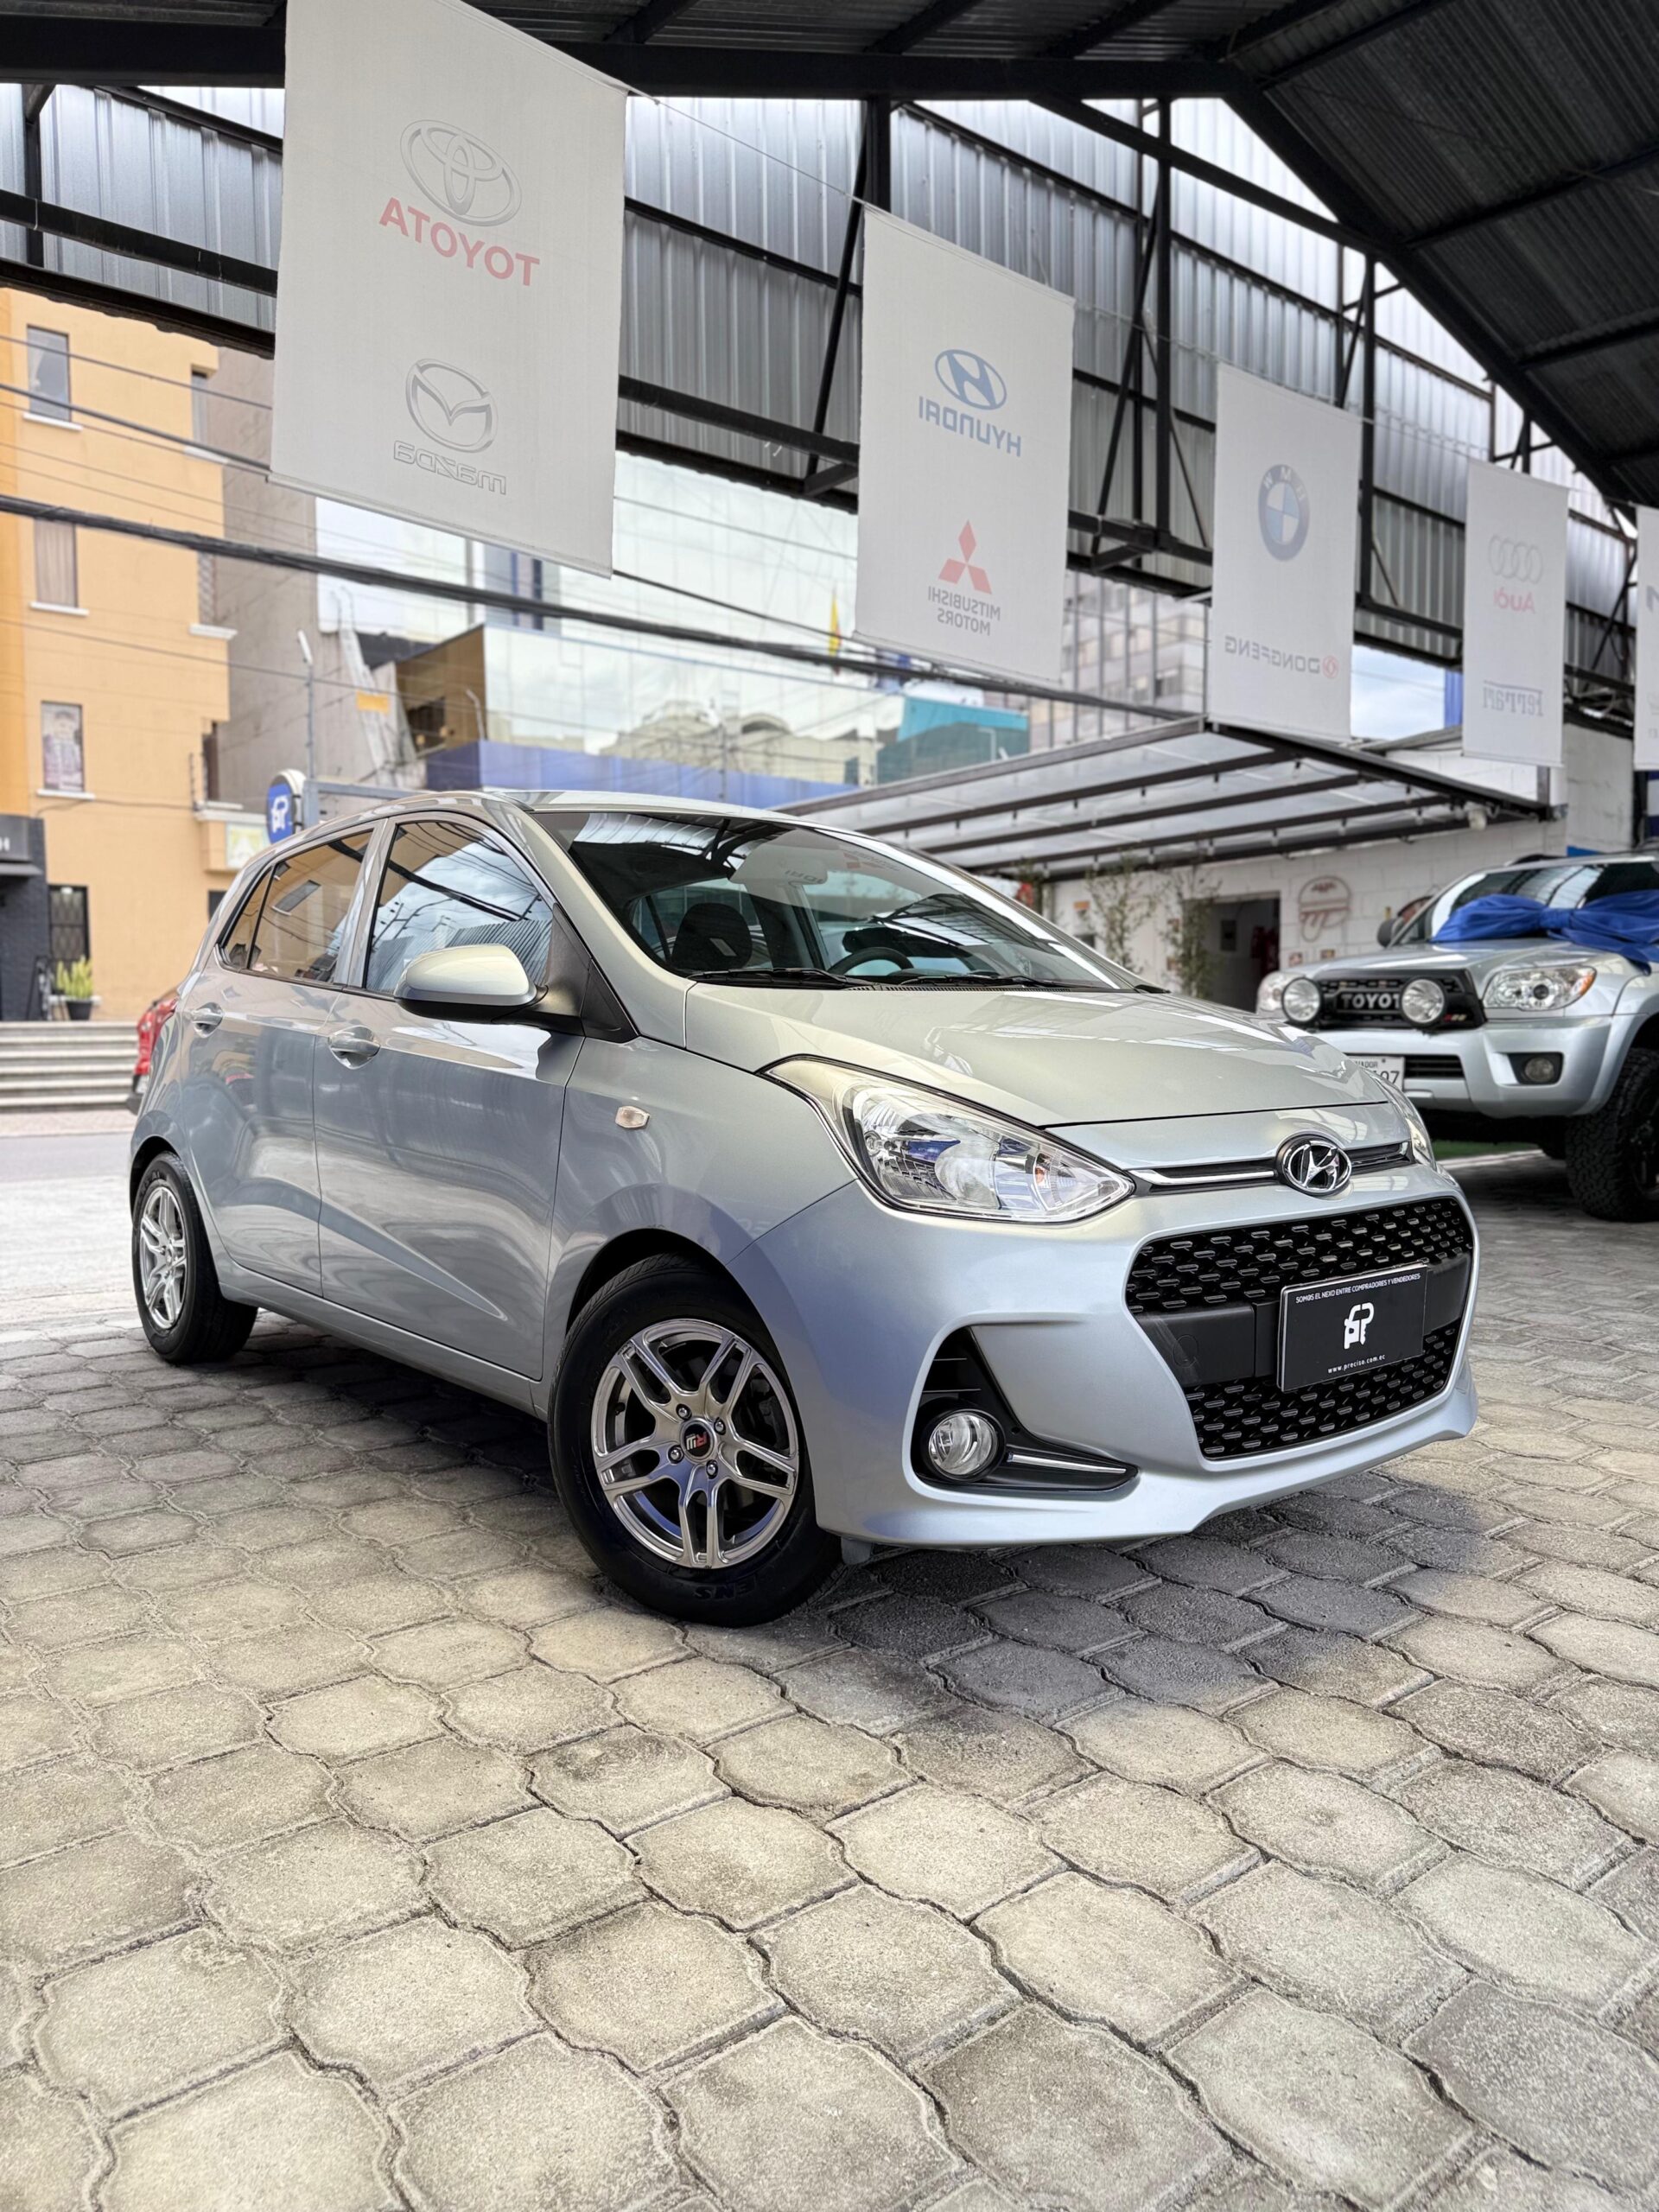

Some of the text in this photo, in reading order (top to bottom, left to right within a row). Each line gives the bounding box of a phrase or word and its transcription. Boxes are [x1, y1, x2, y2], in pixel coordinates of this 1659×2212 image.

[1340, 993, 1400, 1009] TOYOT
[1295, 1294, 1314, 1303] SOMOS
[1335, 1287, 1351, 1296] ENTRE
[1351, 1279, 1388, 1293] COMPRADORES
[1391, 1273, 1421, 1285] VENDEDORES
[1327, 1354, 1386, 1374] www.preciso.com.ec
